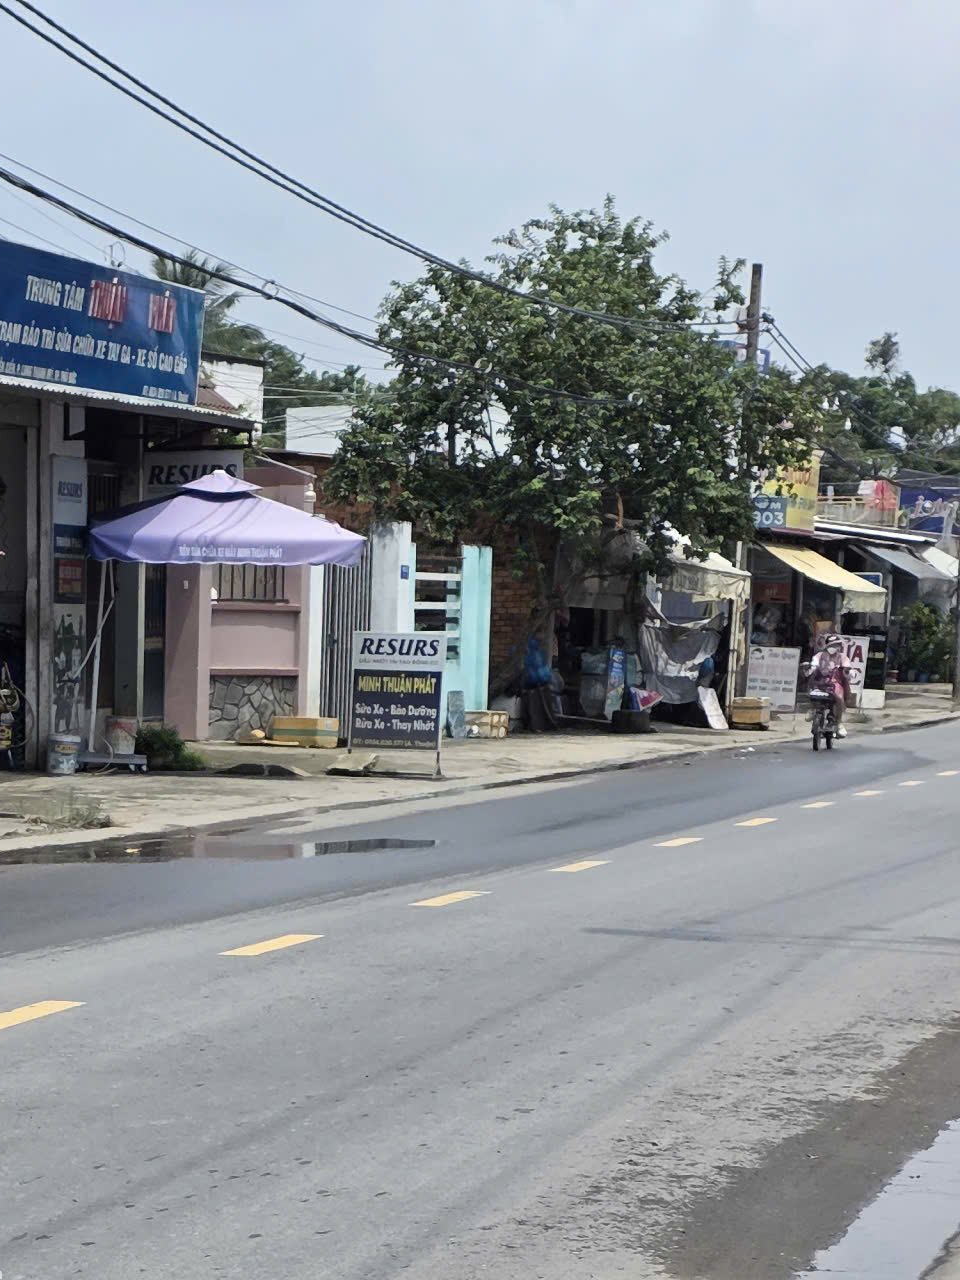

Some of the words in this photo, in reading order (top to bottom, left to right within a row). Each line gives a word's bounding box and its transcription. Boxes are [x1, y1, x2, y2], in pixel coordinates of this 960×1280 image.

[25, 274, 63, 307] TRUNG
[62, 280, 86, 312] TÂM
[20, 319, 41, 347] BẢO
[40, 326, 57, 350] TRÌ
[55, 326, 73, 353] SỬA
[72, 333, 96, 357] CHỮA
[94, 339, 108, 360] XE
[120, 344, 132, 365] GA
[136, 348, 148, 367] XE
[147, 345, 159, 370] SỐ
[158, 352, 174, 372] CAO
[148, 463, 238, 485] RESUS
[359, 637, 440, 657] RESURS
[358, 675, 382, 692] MINH
[382, 673, 413, 698] THUẬN
[413, 673, 437, 694] PHÁT
[355, 702, 372, 714] Sửa
[372, 703, 385, 715] Xe
[390, 703, 407, 716] Bảo
[408, 704, 438, 719] Dưỡng
[355, 717, 373, 729] Rửa
[374, 718, 386, 730] Xe
[391, 719, 412, 733] Thay
[413, 719, 436, 731] Nhớt
